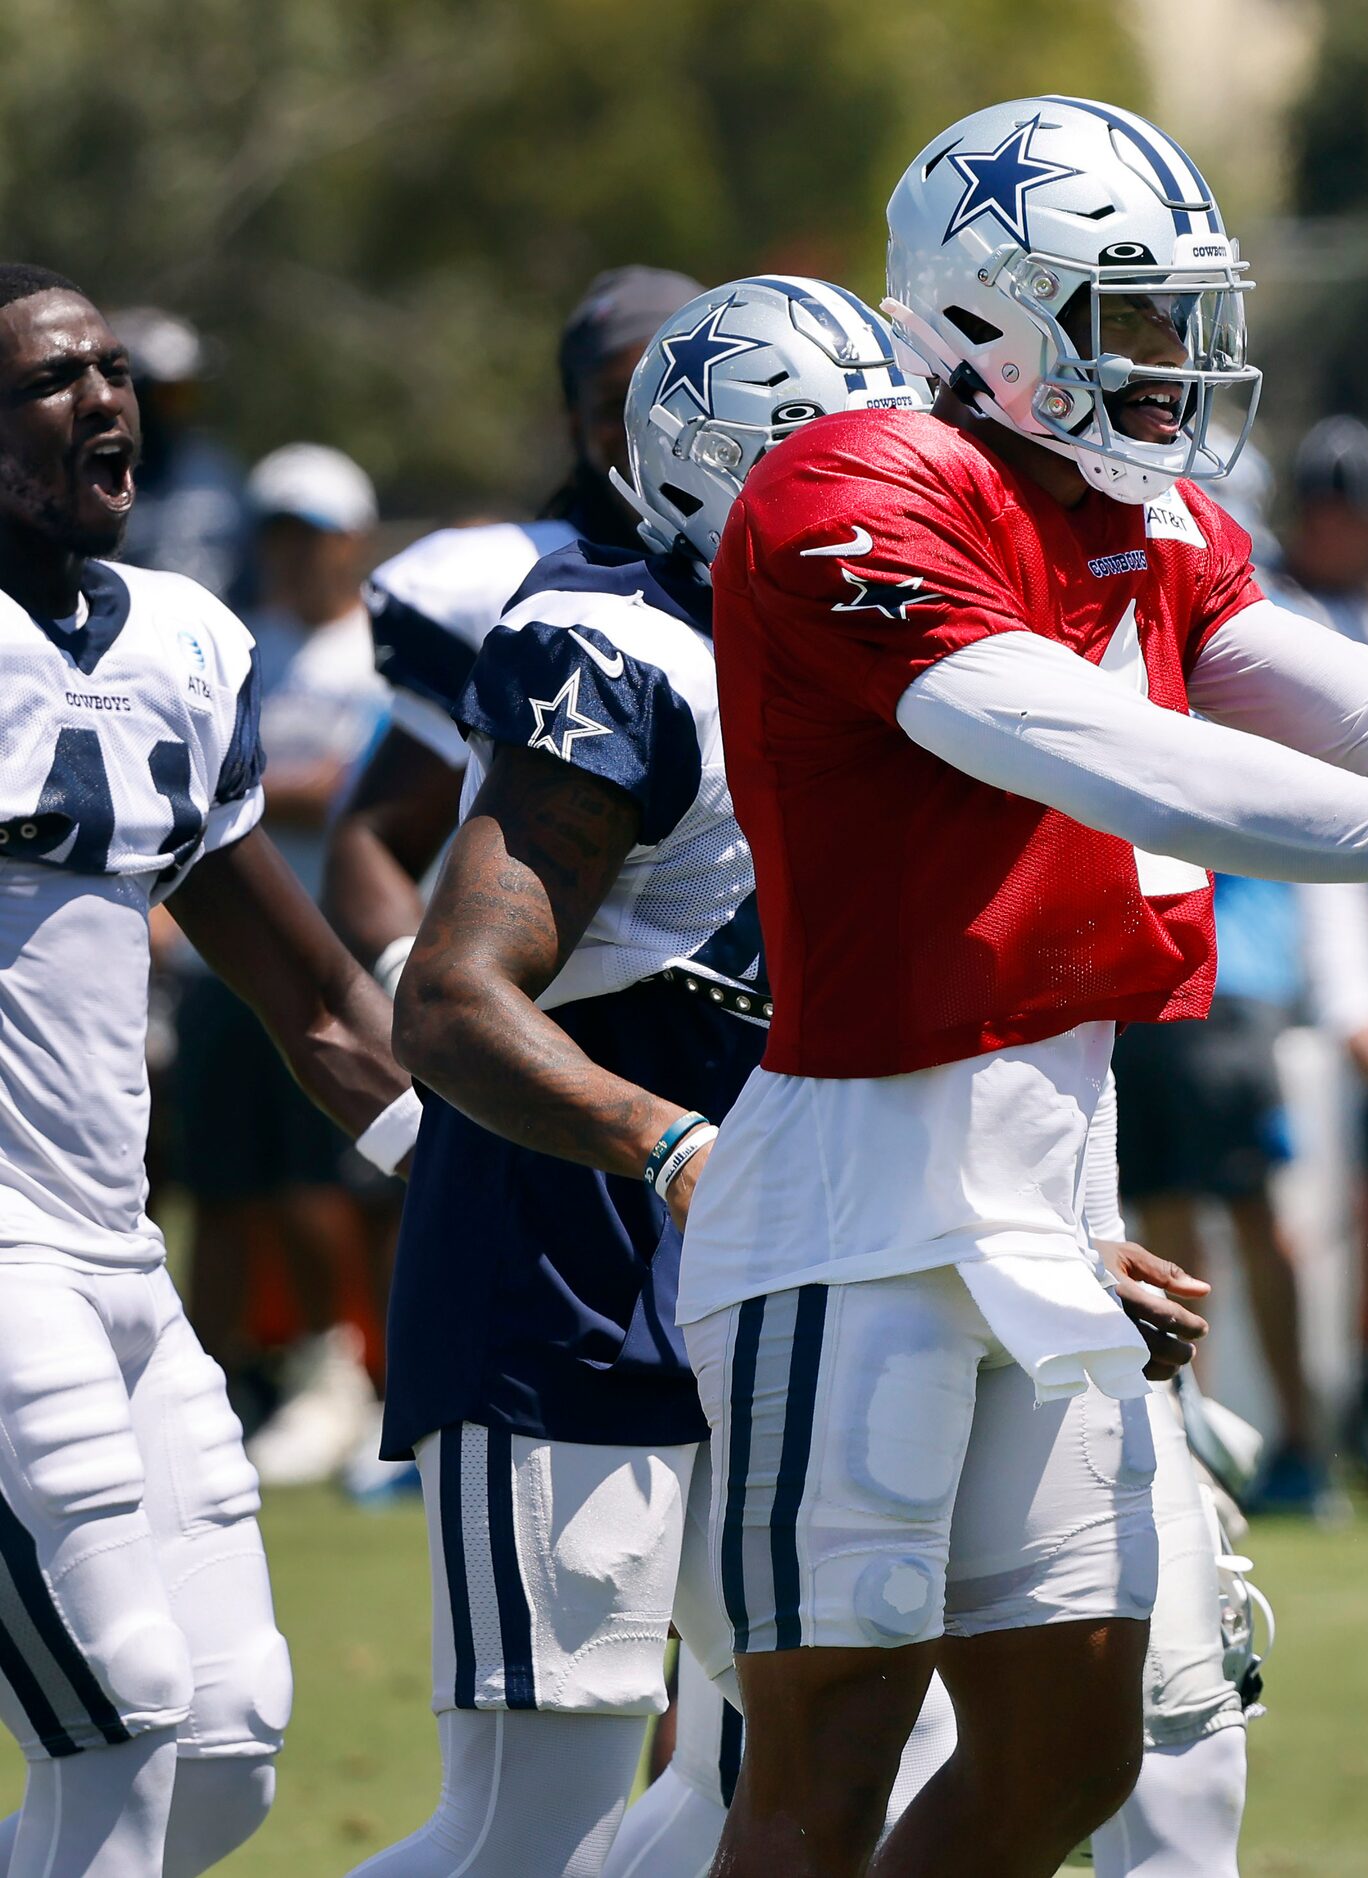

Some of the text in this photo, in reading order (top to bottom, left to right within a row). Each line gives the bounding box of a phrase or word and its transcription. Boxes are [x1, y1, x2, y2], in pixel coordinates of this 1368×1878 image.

[1147, 506, 1187, 531] AT&T
[1088, 550, 1148, 578] COWBOYS
[66, 691, 131, 712] COWBOYS
